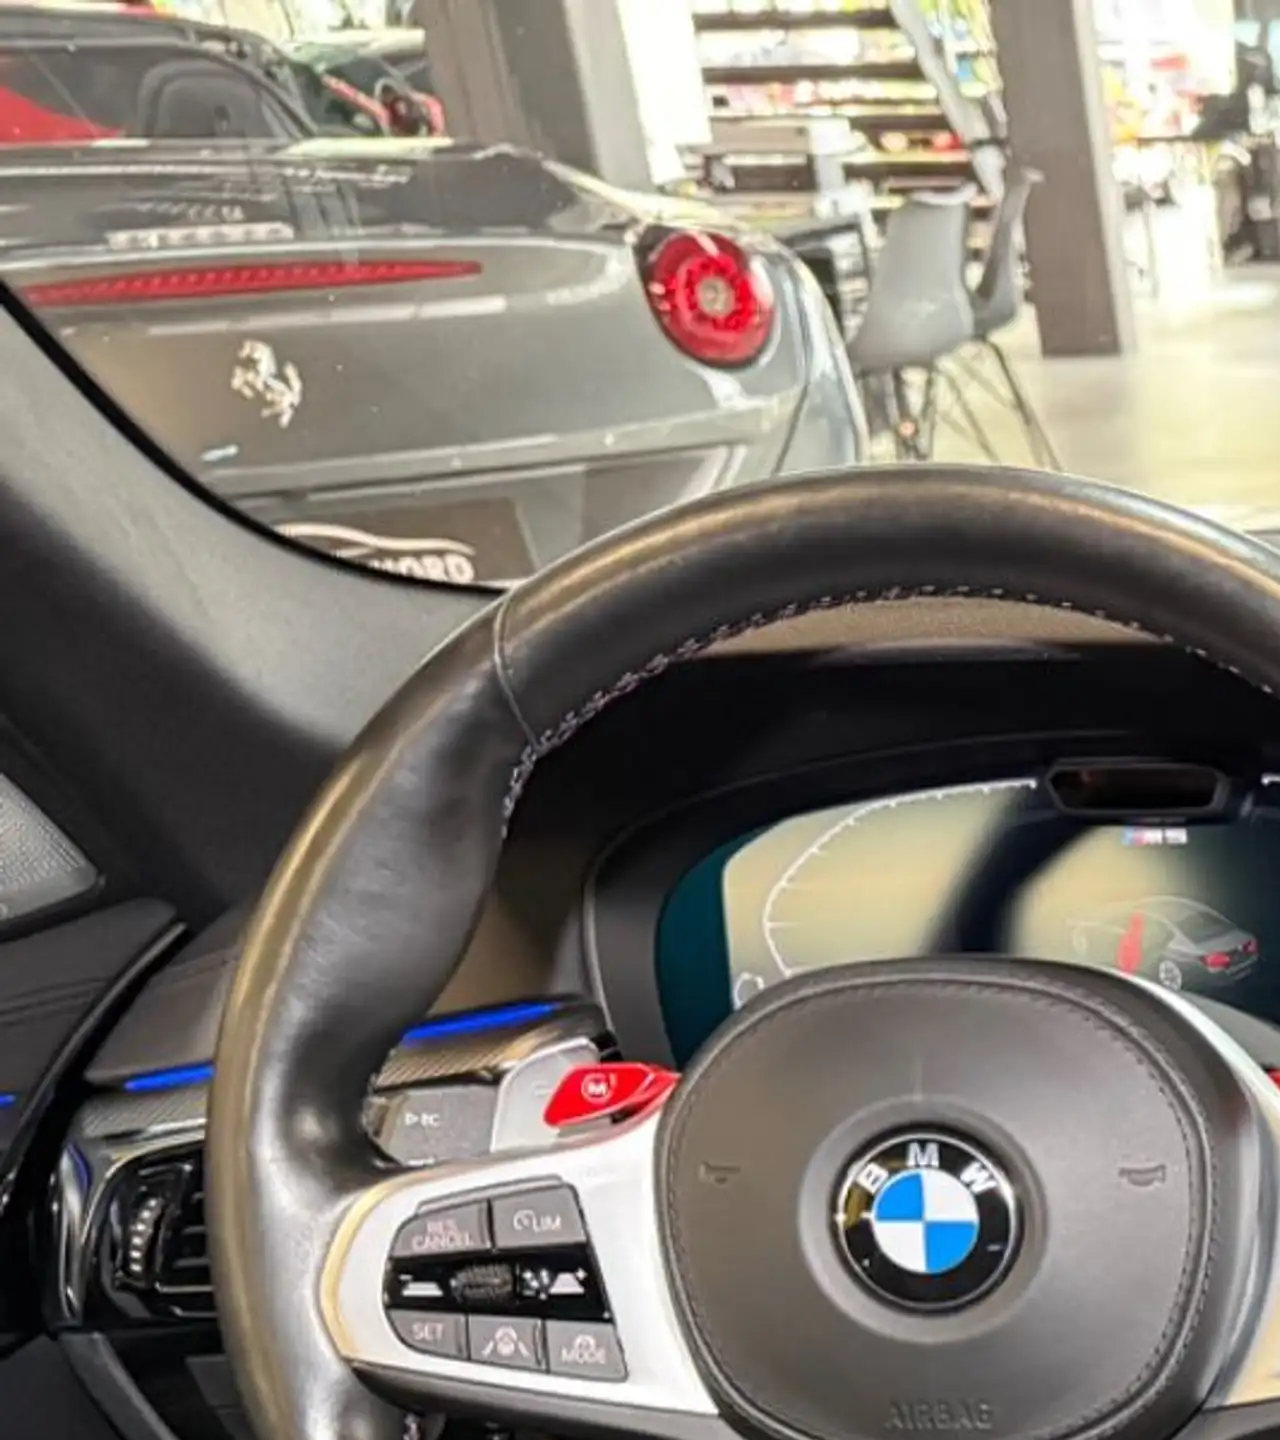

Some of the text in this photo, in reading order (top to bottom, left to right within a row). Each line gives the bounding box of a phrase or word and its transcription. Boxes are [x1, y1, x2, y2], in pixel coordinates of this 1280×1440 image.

[856, 1142, 999, 1196] BMW
[411, 1230, 475, 1251] CANCEL
[411, 1322, 445, 1343] SET
[885, 1401, 994, 1431] AIRBAG
